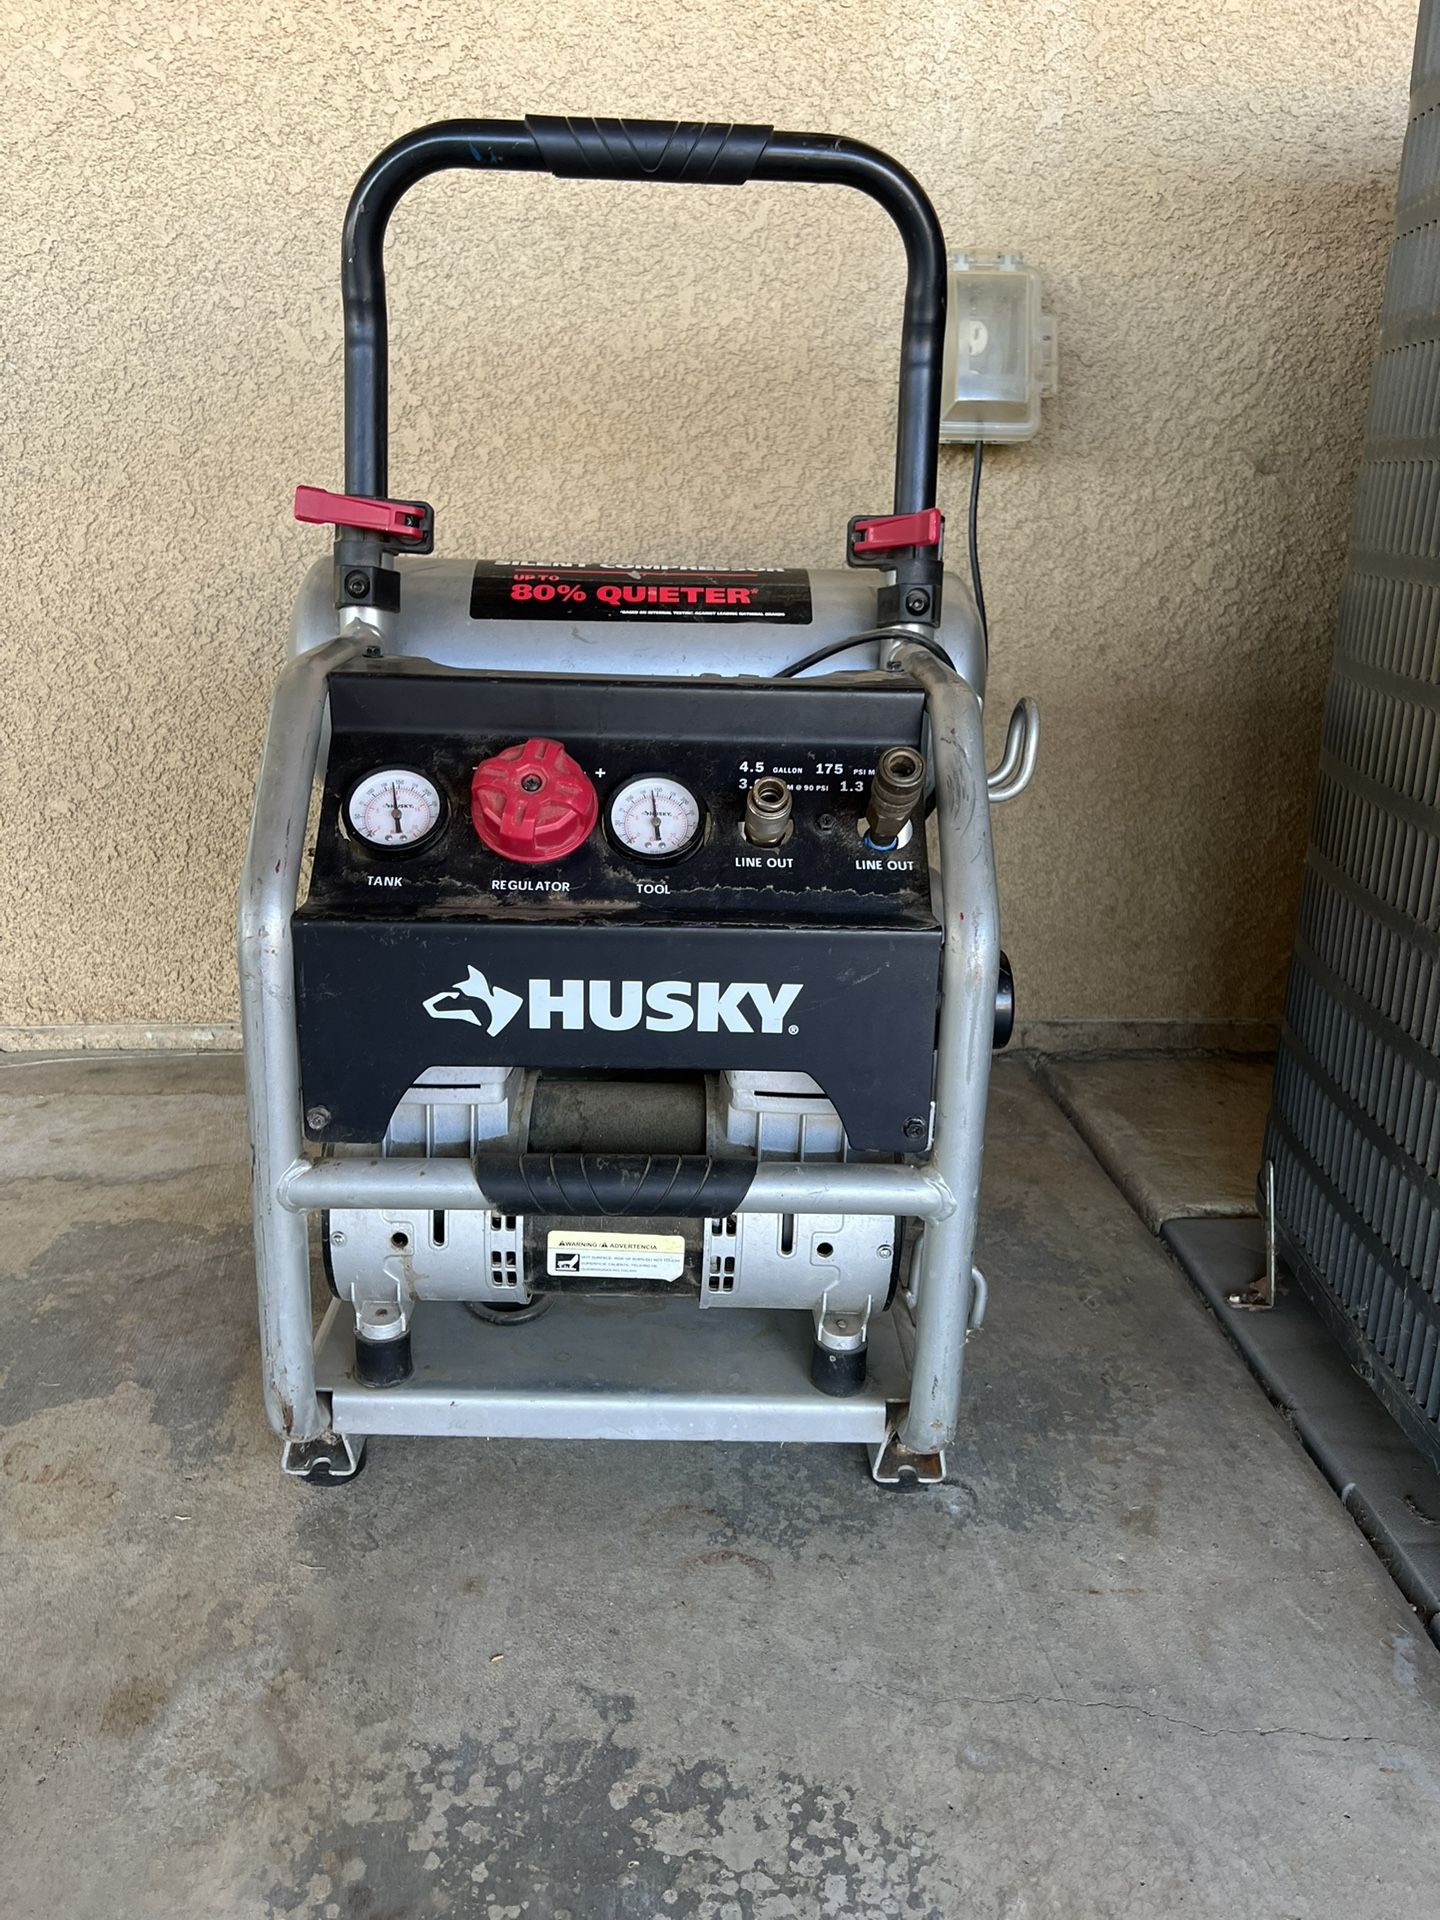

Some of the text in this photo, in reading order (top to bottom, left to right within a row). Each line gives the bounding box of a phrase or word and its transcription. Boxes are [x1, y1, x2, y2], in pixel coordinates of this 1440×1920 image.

[511, 583, 587, 602] 80%
[739, 761, 764, 773] 4.5
[772, 766, 803, 774] GALLON
[815, 763, 844, 774] 175
[738, 778, 761, 790] 3.
[840, 780, 864, 792] 1.3
[735, 857, 794, 868] LINE OUT
[855, 859, 914, 871] LINE OUT
[367, 875, 403, 887] TANK
[491, 879, 571, 892] REGULATOR
[636, 883, 671, 894] TOOL
